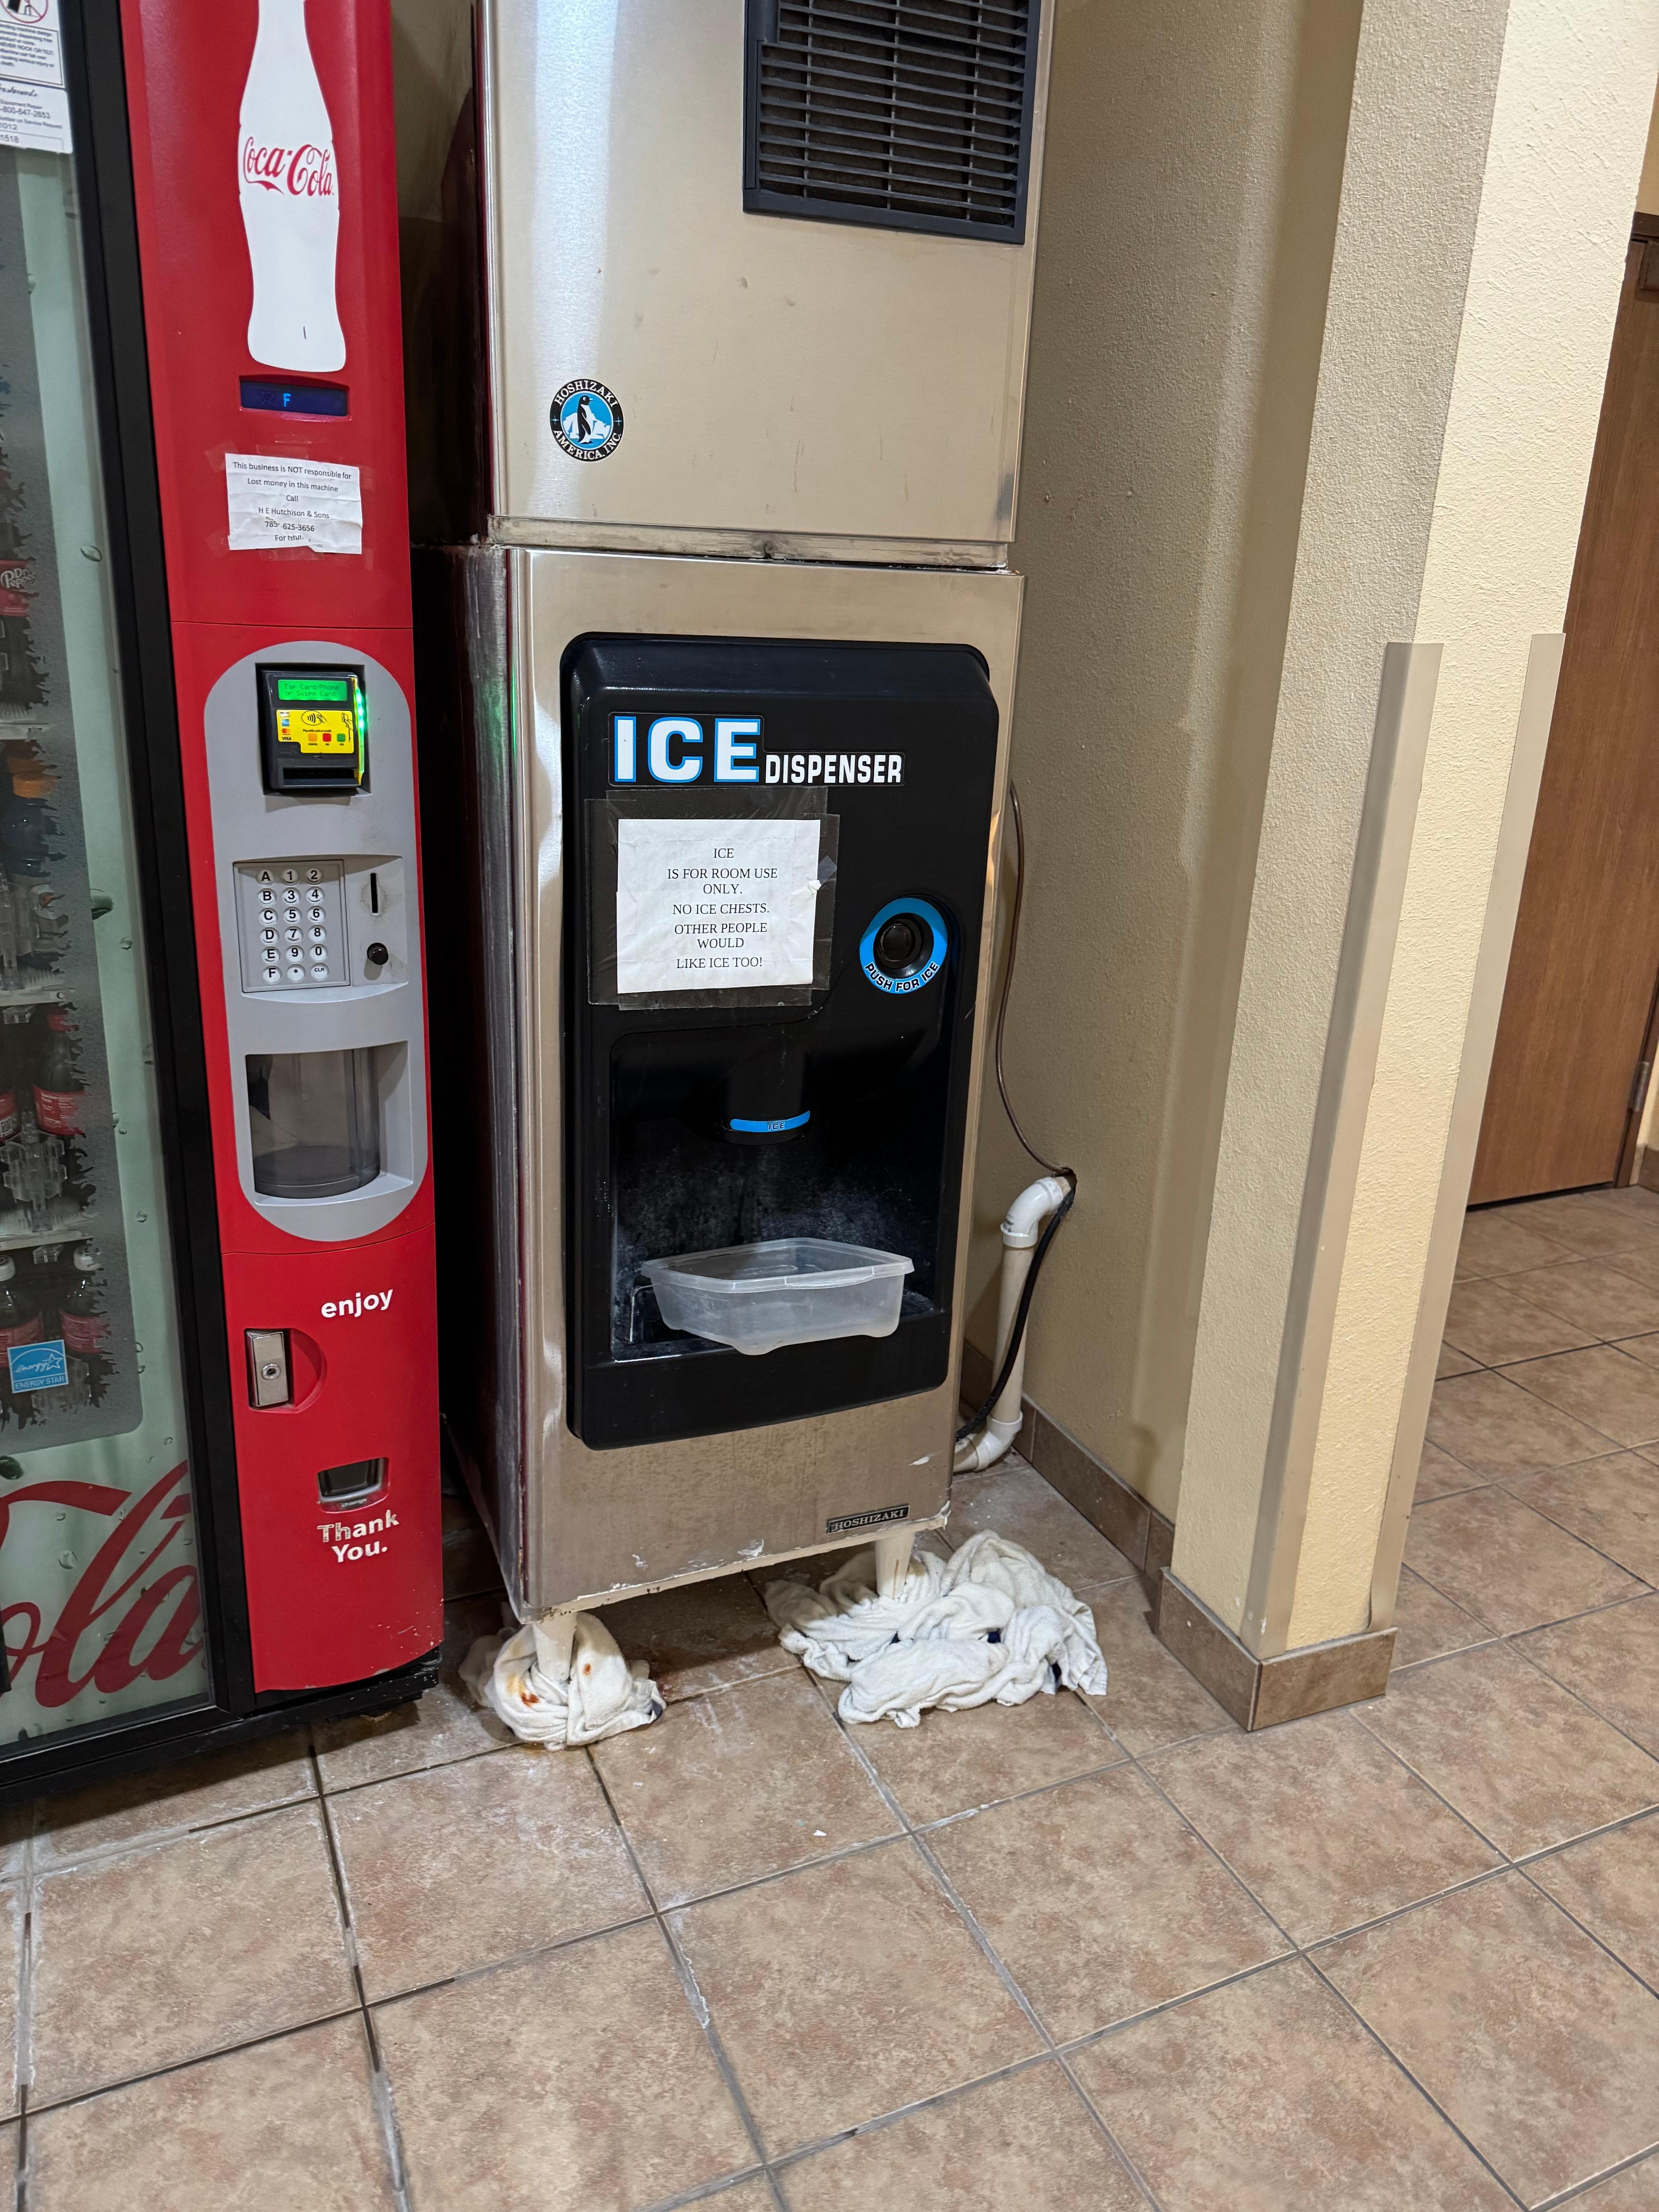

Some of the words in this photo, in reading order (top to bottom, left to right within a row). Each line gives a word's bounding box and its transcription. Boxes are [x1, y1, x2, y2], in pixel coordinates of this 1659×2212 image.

[243, 136, 334, 196] Coca-Cola
[554, 380, 618, 407] HOSHIZAKI
[283, 393, 291, 407] F
[603, 433, 622, 454] INC.
[249, 463, 279, 472] business
[304, 469, 341, 478] responsible
[264, 479, 287, 488] money
[271, 508, 305, 517] Hutchison
[283, 523, 315, 532] 625-3656
[615, 716, 761, 782] ICE
[765, 754, 903, 783] DISPENSER
[713, 848, 734, 859] ICE
[261, 872, 271, 881] A
[287, 871, 293, 880] 1
[310, 871, 318, 880] 2
[667, 868, 679, 879] IS
[683, 868, 708, 879] FOR
[711, 868, 751, 879] ROOM
[754, 868, 778, 879] USE
[703, 883, 743, 894] ONLY.
[263, 891, 271, 901] B
[288, 891, 295, 900] 3
[312, 890, 319, 899] 4
[264, 910, 273, 921] C
[289, 910, 296, 919] 5
[313, 909, 320, 918] 6
[673, 904, 692, 915] NO
[696, 904, 716, 915] ICE
[720, 903, 770, 914] CHESTS.
[265, 930, 274, 940] D
[290, 929, 297, 938] 7
[314, 928, 321, 937] 8
[674, 924, 718, 935] OTHER
[721, 922, 768, 933] PEOPLE
[697, 938, 744, 949] WOULD
[267, 949, 275, 959] E
[291, 948, 298, 957] 9
[315, 947, 322, 956] 0
[676, 958, 706, 969] LIKE
[709, 958, 730, 968] ICE
[732, 957, 763, 968] TOO!
[269, 968, 276, 978] F
[864, 962, 893, 991] PUSH
[895, 978, 920, 992] FOR
[921, 962, 939, 982] ICE
[768, 1122, 785, 1130] ICE
[321, 1289, 393, 1318] enjoy
[341, 1498, 367, 1508] change
[834, 1509, 905, 1530] HOSHIZAKI
[317, 1509, 400, 1543] Thank
[331, 1541, 388, 1563] You.
